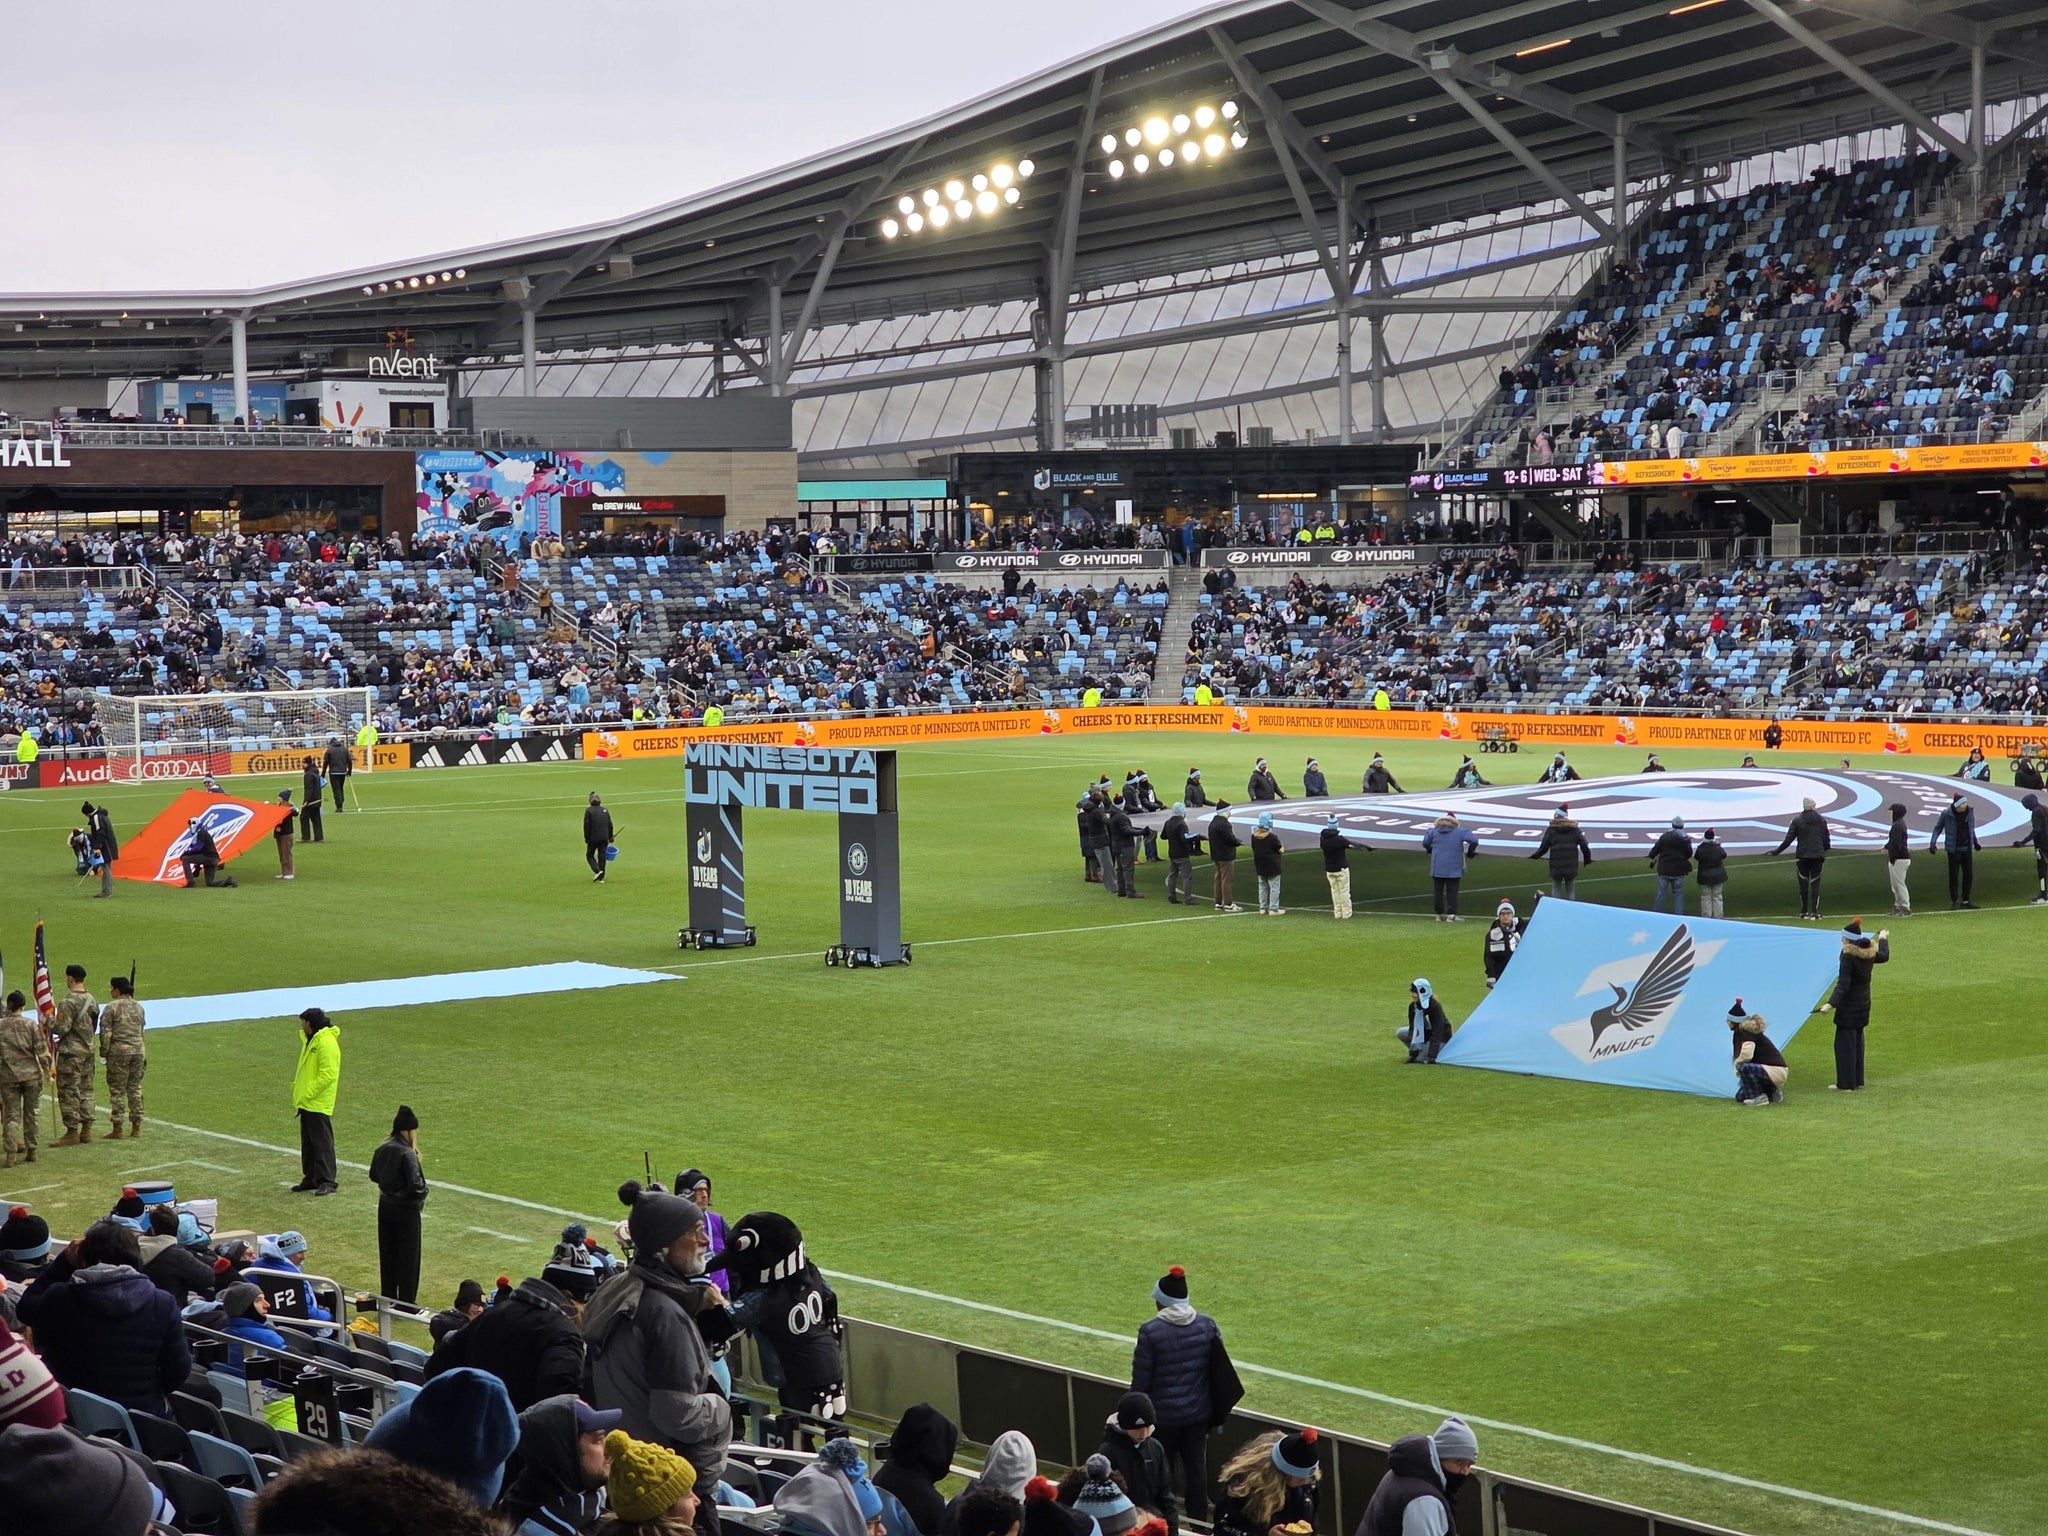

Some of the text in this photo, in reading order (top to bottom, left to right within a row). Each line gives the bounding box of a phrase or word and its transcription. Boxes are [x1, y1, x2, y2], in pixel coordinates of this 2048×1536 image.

[368, 348, 439, 376] nVent
[1053, 473, 1081, 482] BLACK
[1096, 472, 1118, 481] BLUE
[1562, 467, 1582, 482] SAT
[624, 501, 642, 510] HALL
[980, 555, 1039, 566] HYUNDAI
[1083, 554, 1142, 565] HYUNDAI
[1252, 551, 1311, 562] HYUNDAI
[1355, 550, 1415, 561] HYUNDAI
[1457, 548, 1501, 559] HYUNDA
[871, 557, 918, 568] HYUNDAI
[1072, 713, 1224, 727] CHEERS TO REFRESHMENT
[1258, 715, 1431, 732] PROUD PARTNER OF MINNESOTA UNITED FC
[829, 718, 1031, 739] PROUD PARTNER OF MINNESOTA UNITED FC
[1511, 722, 1524, 735] TO
[1527, 722, 1604, 737] REFRESHMENT
[1649, 726, 1872, 744] PROUD PARTNER OF MIESOTA UNITED FC
[633, 737, 678, 751] CHEERS
[1924, 732, 1975, 748] CHEERS
[1976, 734, 1994, 748] TO
[248, 750, 398, 774] Continn Tire
[685, 744, 877, 775] MINNESOTA
[59, 765, 110, 783] Audi
[685, 769, 878, 815] UNITED
[1593, 1034, 1655, 1060] MNUFC
[274, 1288, 297, 1309] F2
[788, 1290, 823, 1335] 00
[304, 1400, 329, 1439] 29
